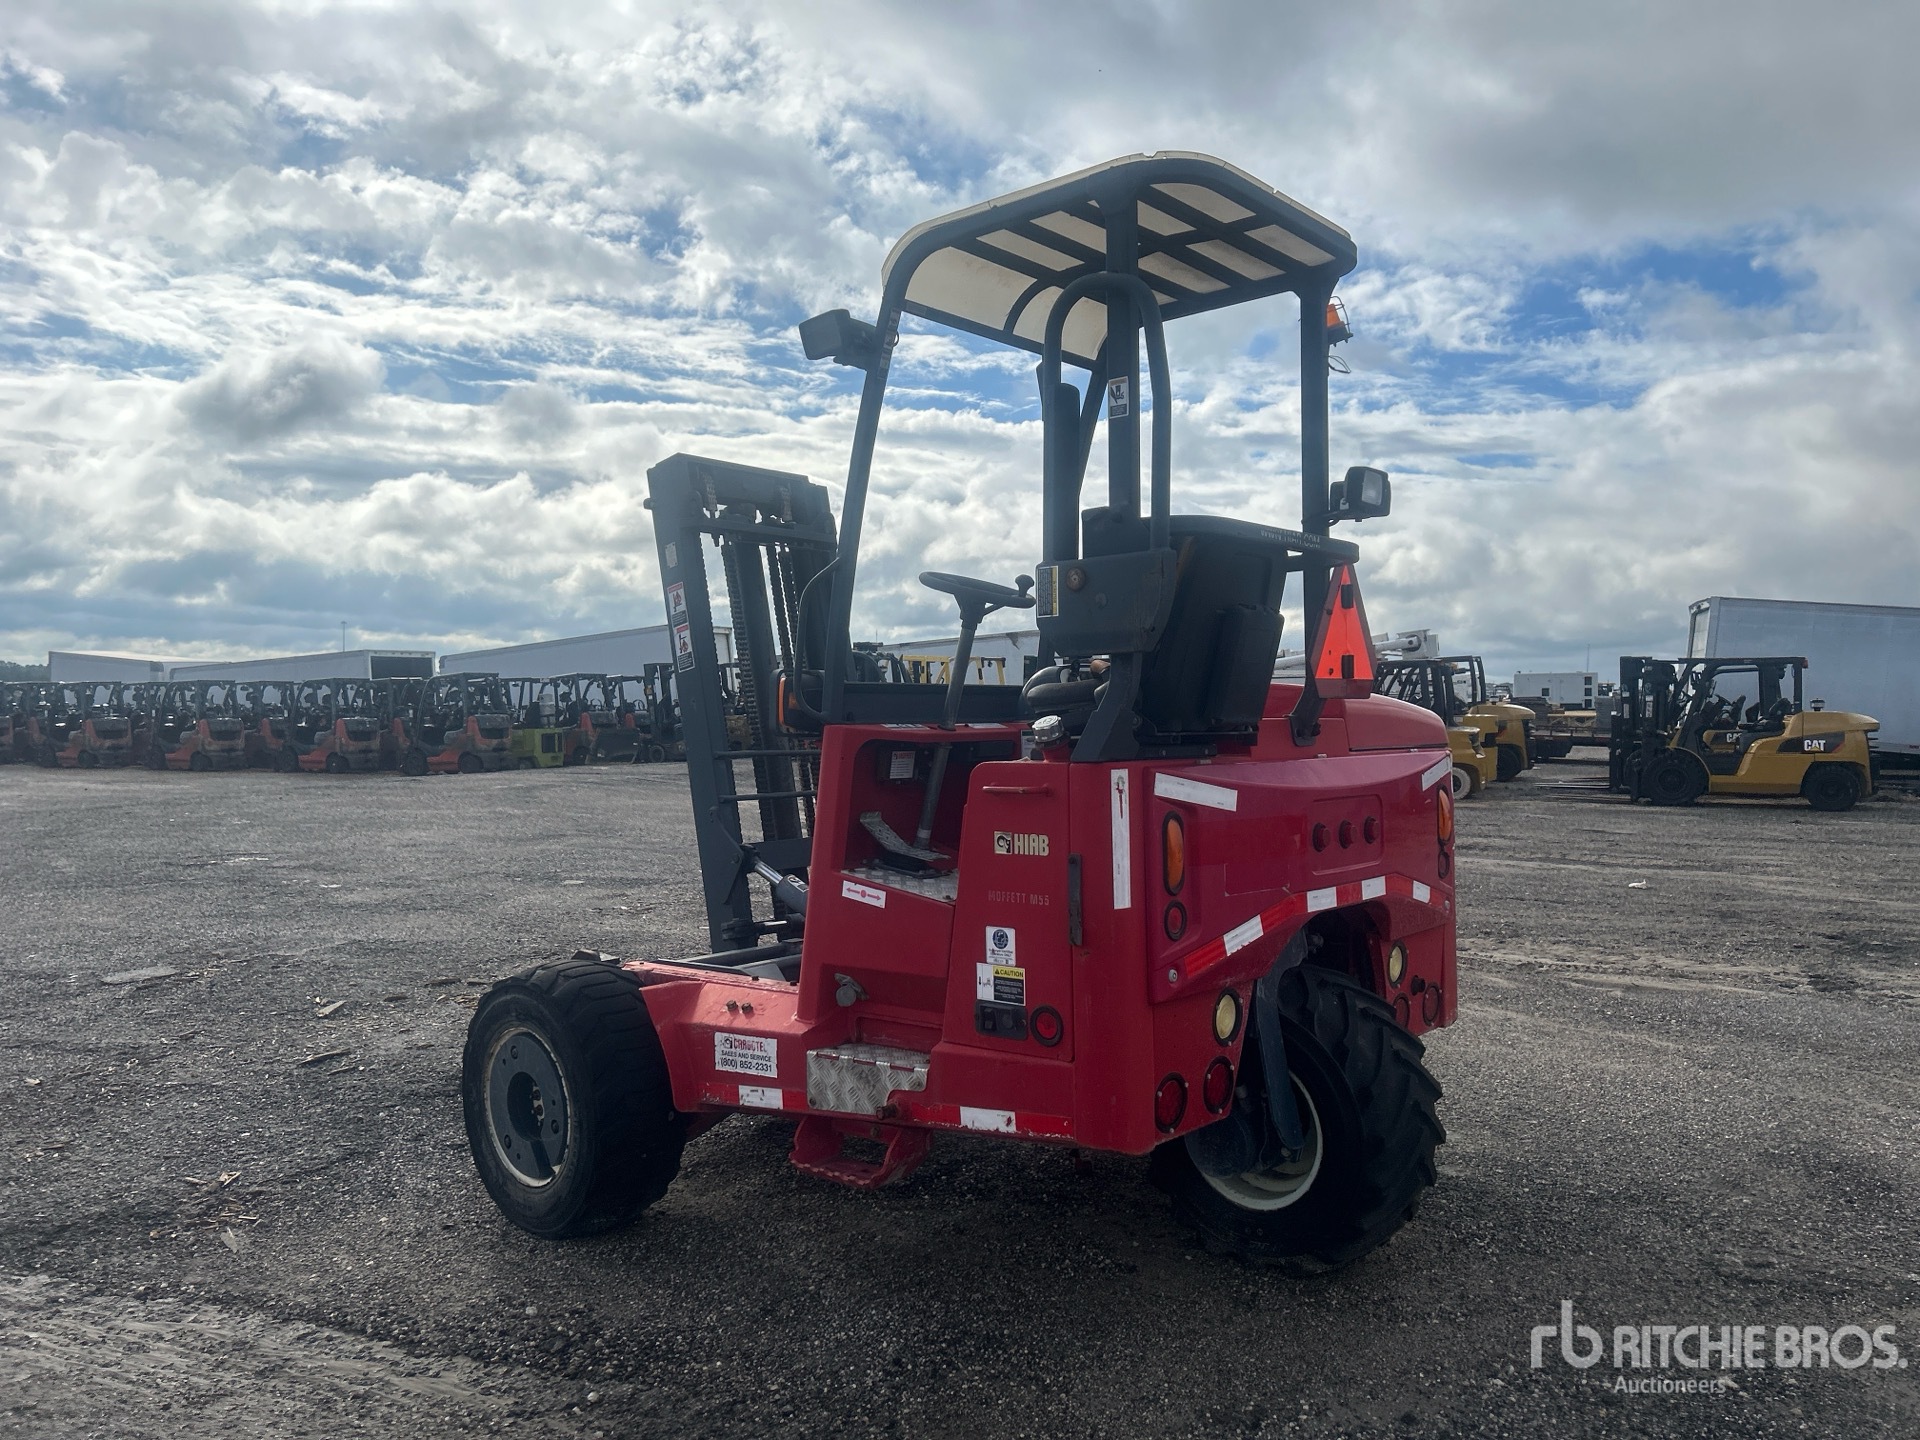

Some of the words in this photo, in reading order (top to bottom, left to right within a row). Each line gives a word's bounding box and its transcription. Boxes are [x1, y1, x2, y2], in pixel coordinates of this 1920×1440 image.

[1726, 732, 1742, 743] CA
[1804, 739, 1826, 752] CAT
[1013, 833, 1049, 857] HIAB
[988, 890, 1026, 904] MOFFETT
[1029, 893, 1050, 906] M55
[1000, 969, 1024, 978] CAUTION
[721, 1050, 737, 1058] SALES
[738, 1052, 749, 1060] AND
[750, 1054, 772, 1063] SERVICE
[720, 1057, 738, 1070] (800)
[739, 1060, 772, 1073] 852-2331
